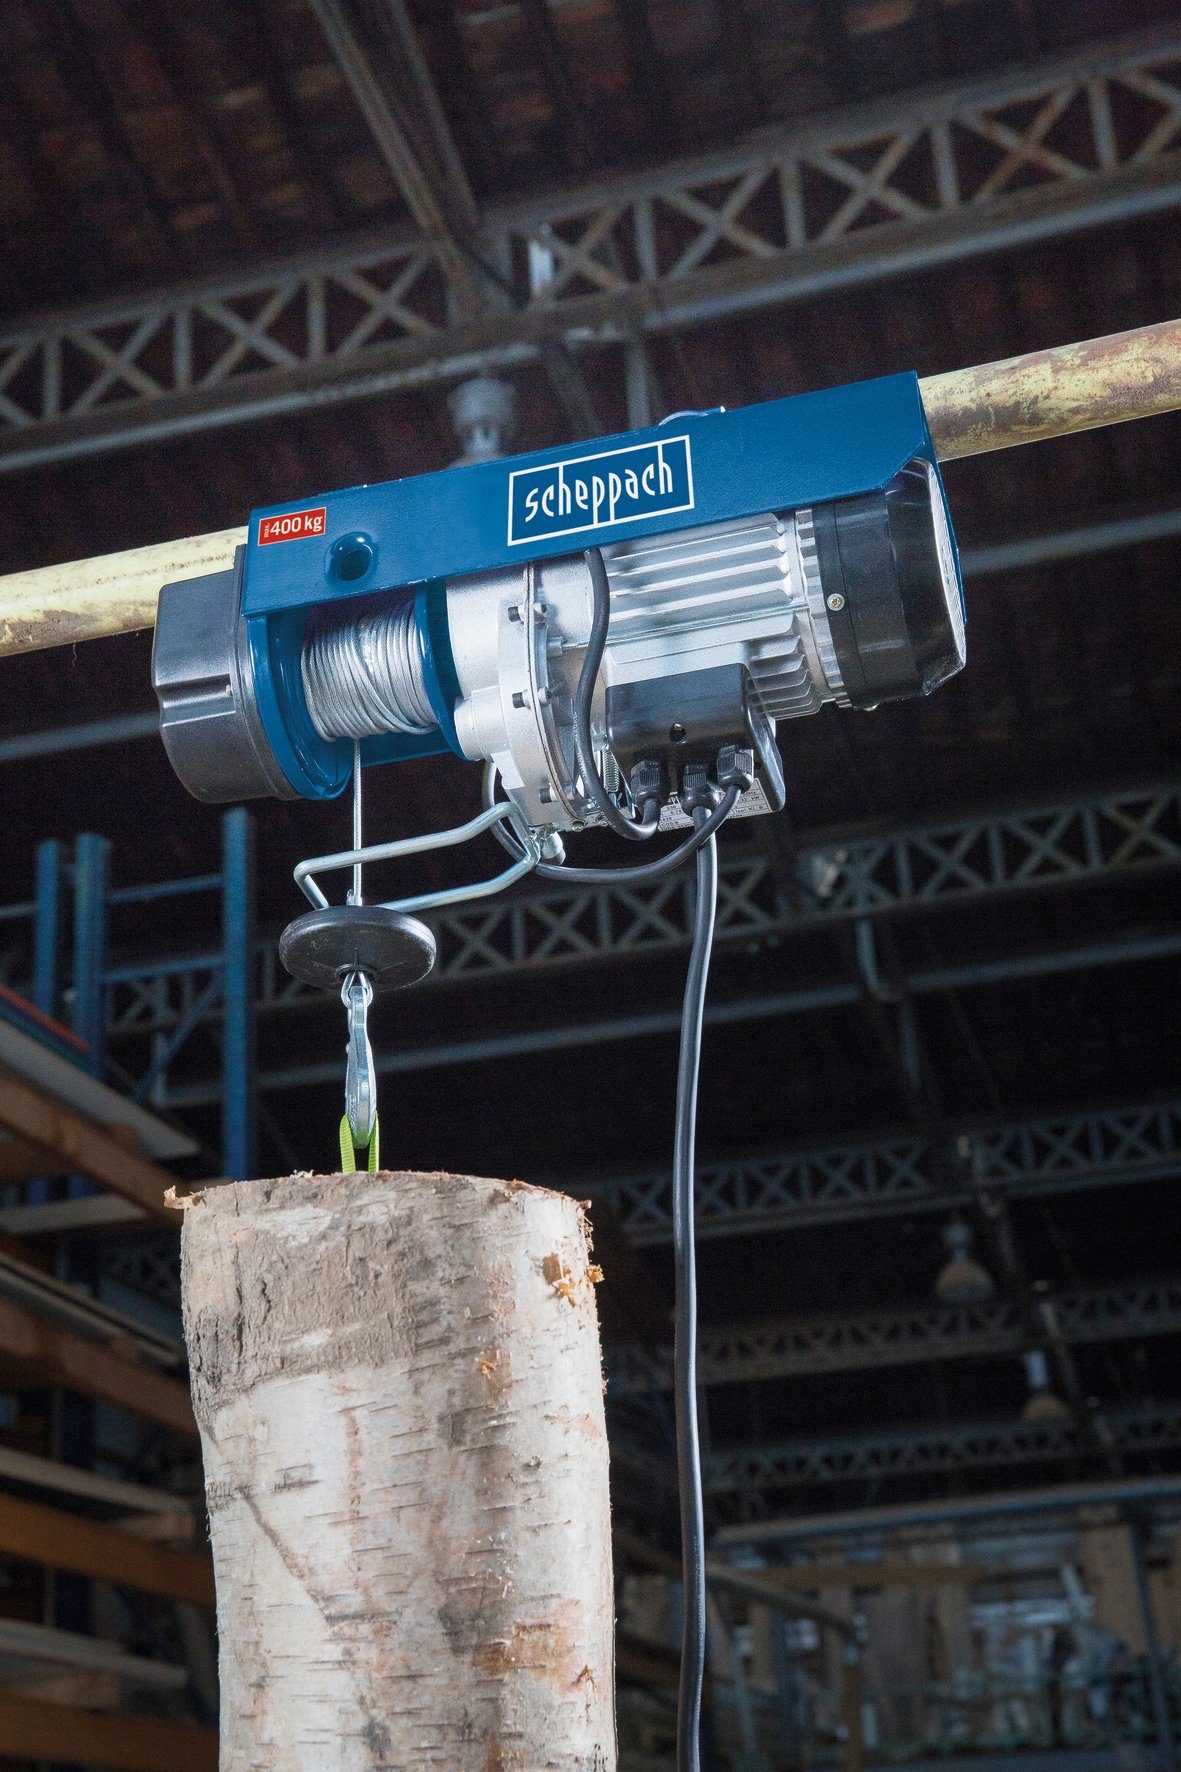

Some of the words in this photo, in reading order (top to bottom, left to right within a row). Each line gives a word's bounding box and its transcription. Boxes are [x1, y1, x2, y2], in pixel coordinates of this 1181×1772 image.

[524, 439, 674, 525] scheppach
[270, 517, 301, 536] 400
[304, 515, 323, 533] kg
